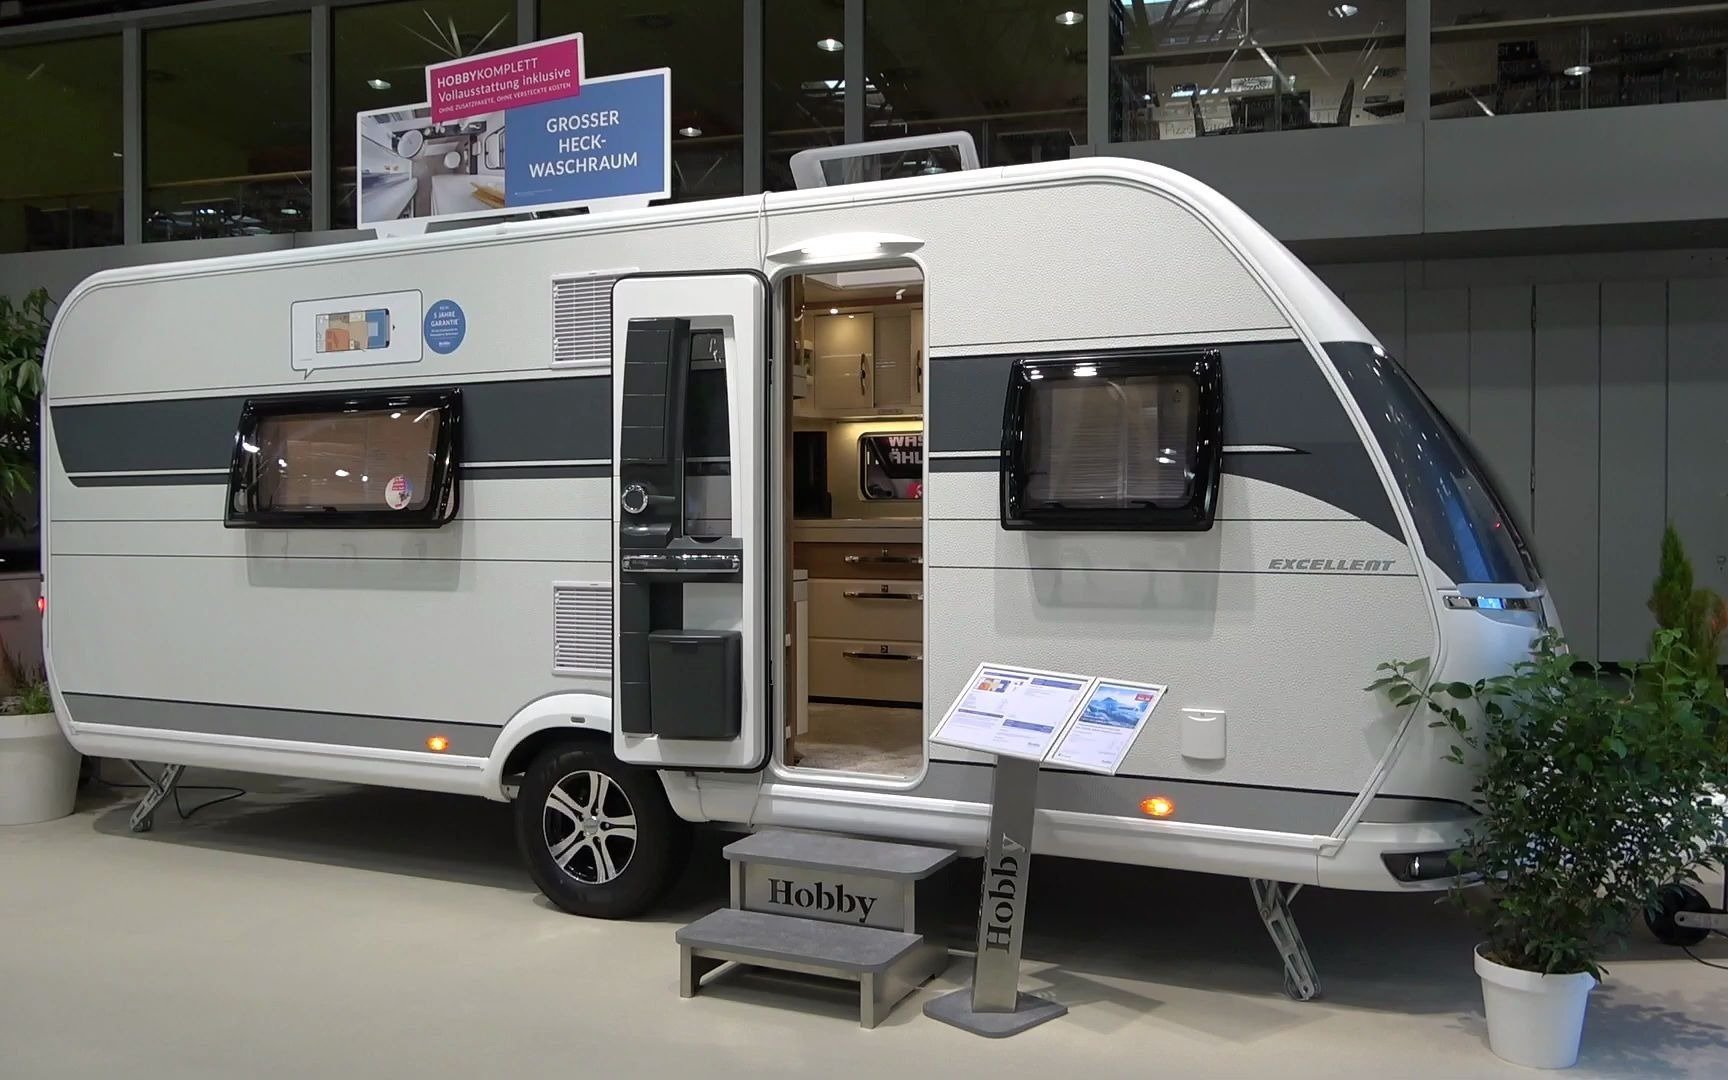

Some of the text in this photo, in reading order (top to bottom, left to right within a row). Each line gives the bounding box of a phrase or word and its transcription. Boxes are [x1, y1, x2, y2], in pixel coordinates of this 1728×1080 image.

[437, 57, 538, 89] HOBBYKOMPLETT
[438, 68, 571, 103] Vollausstattung inklusive
[438, 105, 454, 114] OHNE
[496, 93, 512, 102] OHNE
[513, 87, 548, 99] VERSTECKTE
[548, 82, 571, 92] KOSTEN
[546, 110, 619, 133] GROSSER
[558, 134, 607, 153] HECK-
[529, 152, 638, 179] WASCHRAUM
[1268, 558, 1396, 571] EXCELLENT
[768, 878, 877, 923] Hobby
[986, 831, 1027, 954] Hobby
